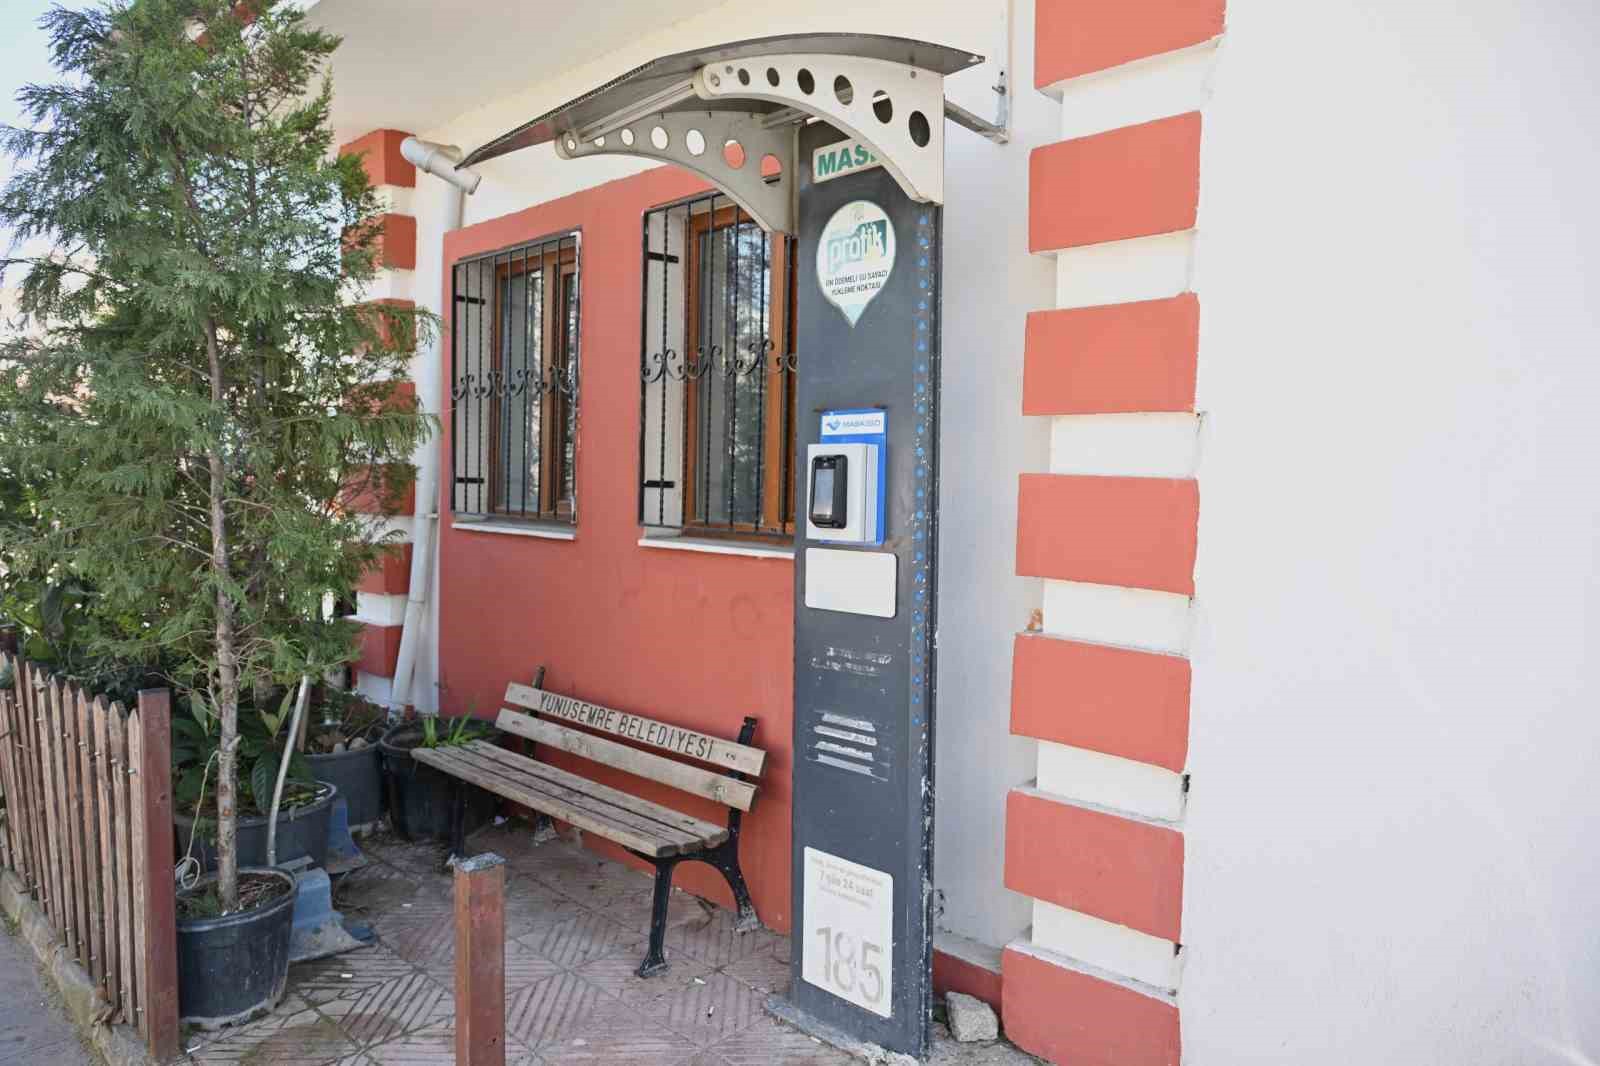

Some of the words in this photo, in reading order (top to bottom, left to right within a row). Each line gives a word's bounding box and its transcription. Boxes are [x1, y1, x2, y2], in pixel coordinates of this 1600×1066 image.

[541, 693, 616, 730] YUNUSEMRE
[843, 878, 854, 889] 24
[816, 928, 884, 1002] 185
